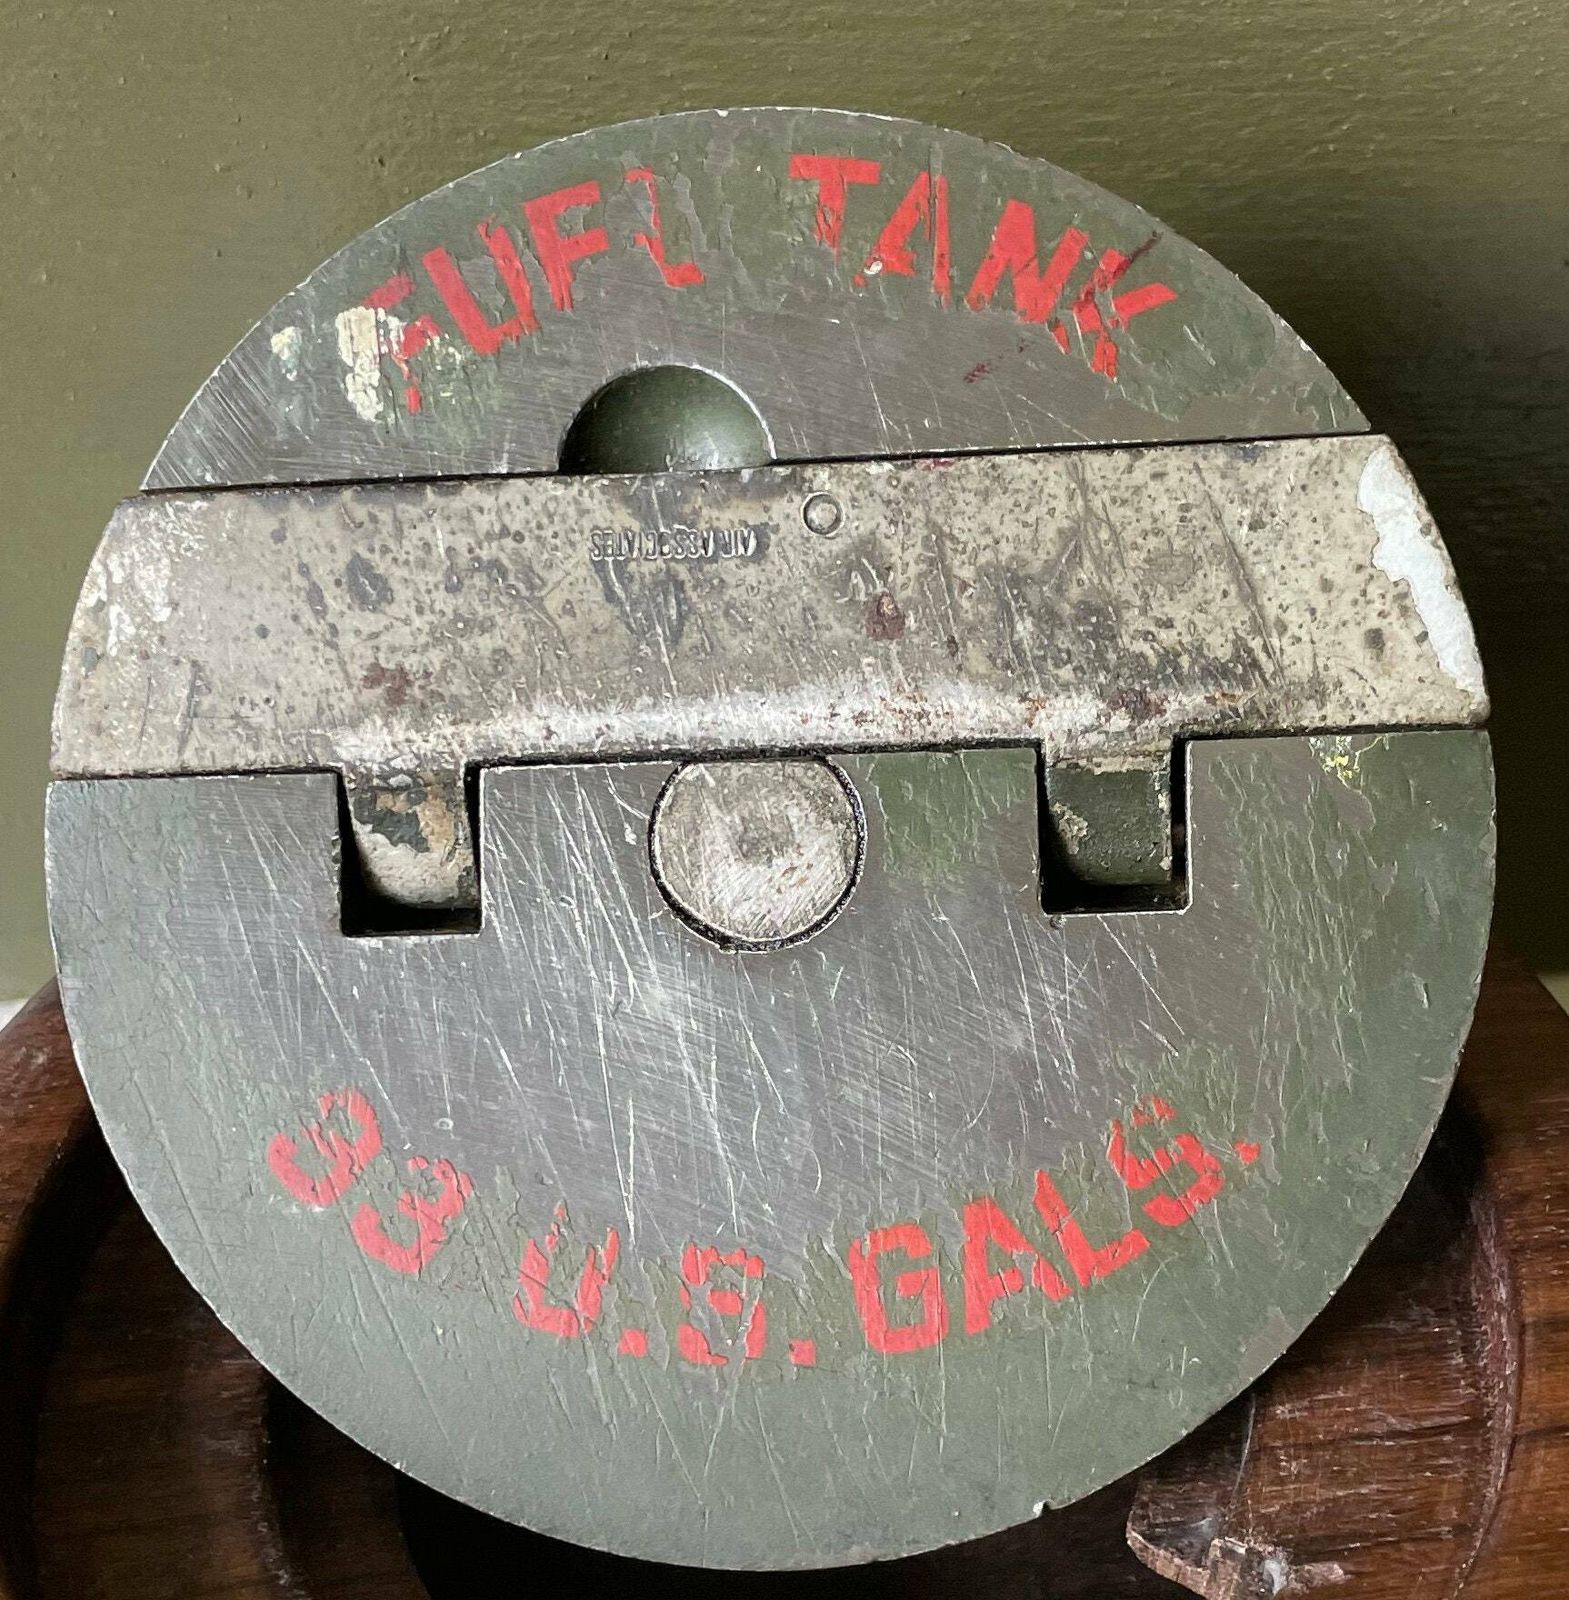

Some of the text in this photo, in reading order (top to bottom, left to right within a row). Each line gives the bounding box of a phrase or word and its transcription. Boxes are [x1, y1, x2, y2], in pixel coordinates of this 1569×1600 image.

[788, 153, 1178, 382] TANK
[589, 526, 758, 561] AIR ASSOCIATES
[266, 1085, 475, 1275] 33
[847, 1093, 1262, 1354] GALS.
